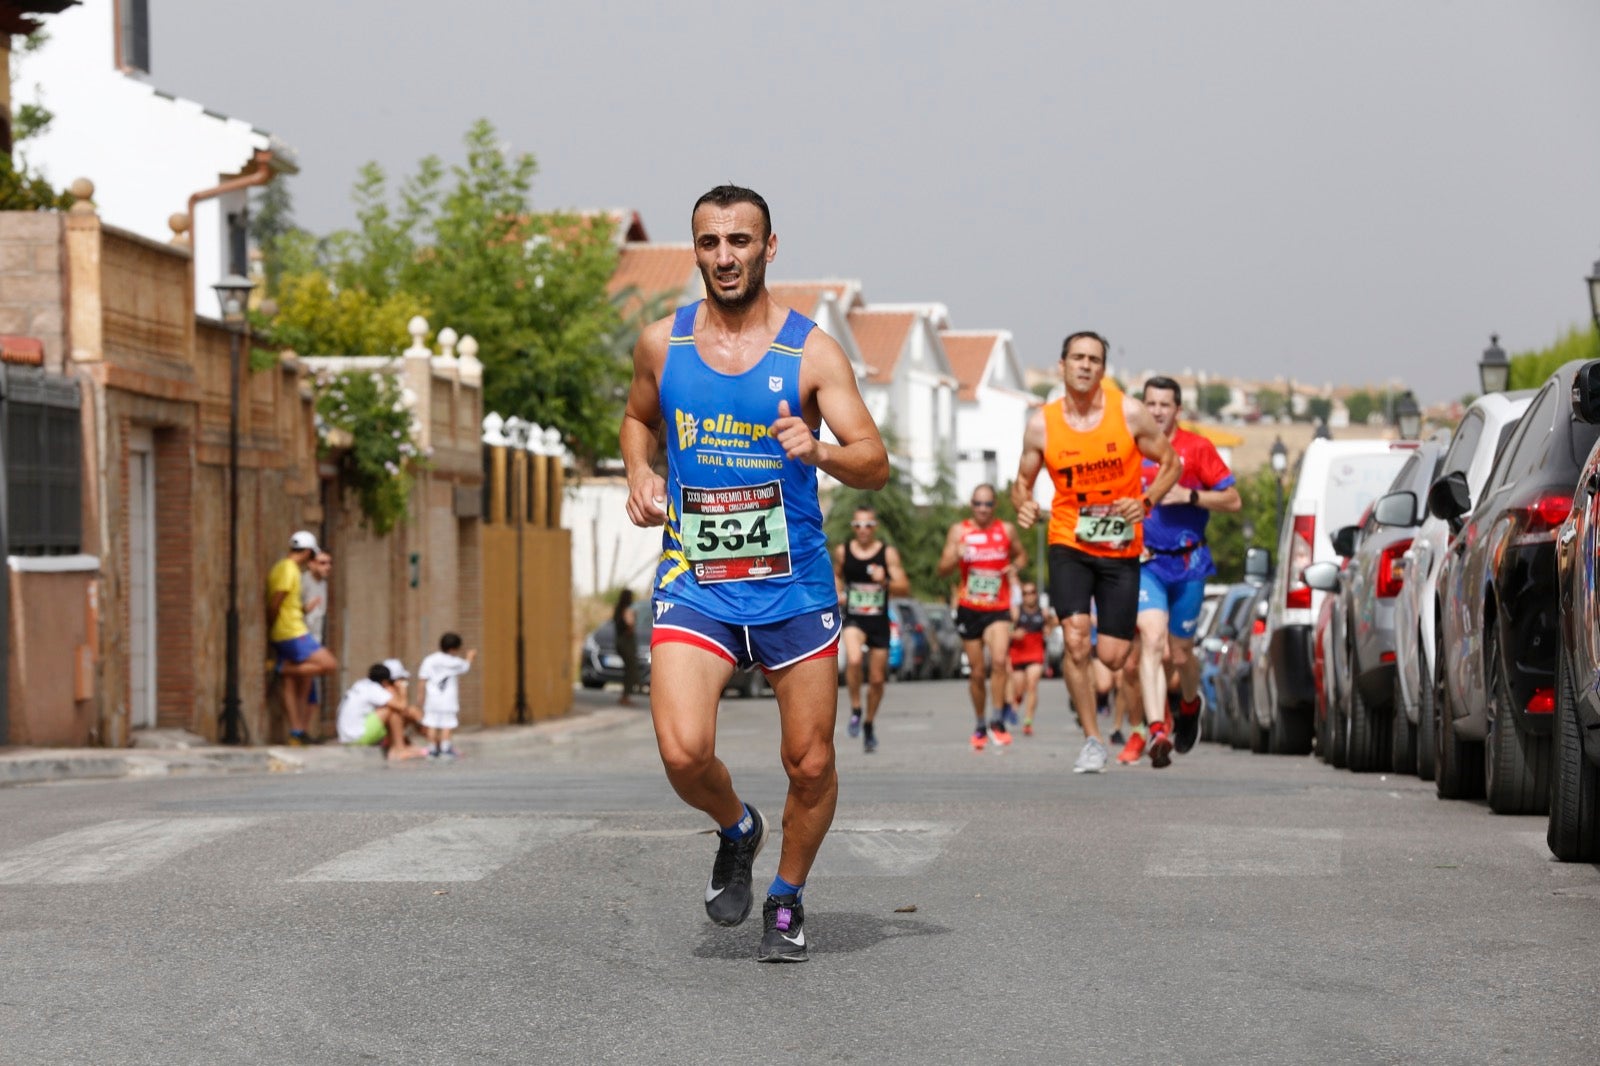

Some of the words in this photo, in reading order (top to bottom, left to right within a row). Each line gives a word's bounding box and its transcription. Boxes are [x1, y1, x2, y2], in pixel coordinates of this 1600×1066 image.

[701, 434, 750, 448] deportes
[697, 454, 724, 467] TRAIL
[726, 457, 734, 467] &
[736, 458, 783, 470] RUNNING
[716, 491, 742, 503] PREMIO
[743, 490, 752, 501] DE
[753, 486, 775, 500] FONDO
[697, 515, 771, 552] 534
